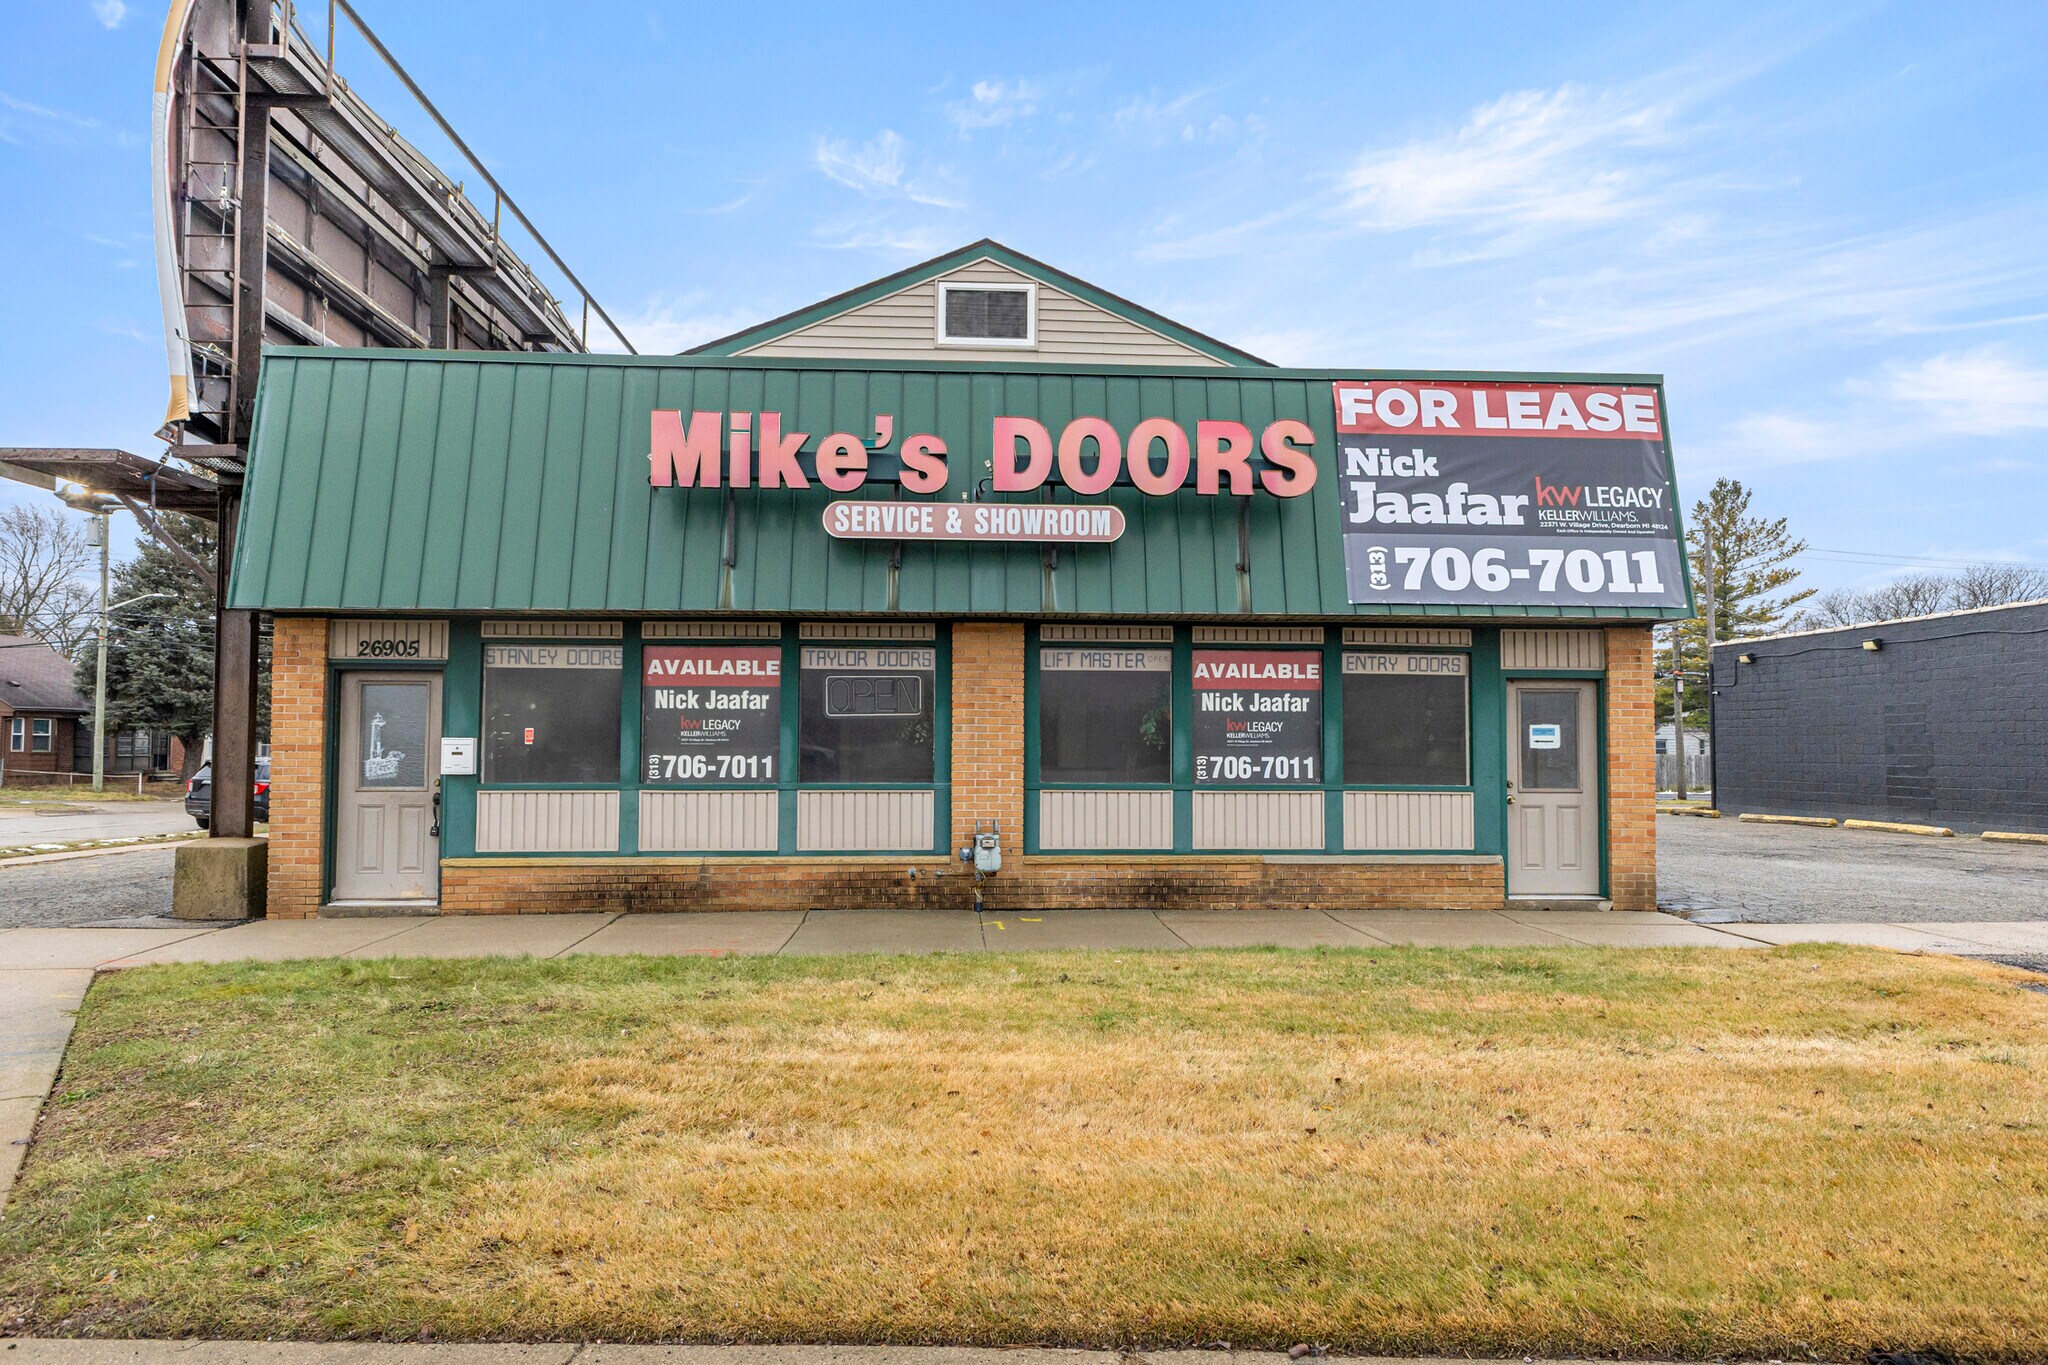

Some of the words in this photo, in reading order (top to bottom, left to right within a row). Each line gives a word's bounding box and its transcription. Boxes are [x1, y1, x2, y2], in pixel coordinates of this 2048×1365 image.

[1339, 388, 1461, 428] FOR
[1472, 390, 1658, 433] LEASE
[650, 409, 949, 494] Mike's
[993, 416, 1319, 498] DOORS
[1345, 448, 1439, 477] Nick
[1535, 475, 1581, 508] kw
[1584, 486, 1663, 509] LEGACY
[1349, 481, 1528, 525] Jaafar
[834, 505, 933, 533] SERVICE
[946, 508, 963, 534] &
[974, 507, 1111, 537] SHOWROOM
[1367, 546, 1391, 591] (313)
[1395, 547, 1665, 594] 706-7011
[358, 639, 420, 657] 26905
[485, 648, 558, 665] STANLEY
[567, 648, 622, 666] DOORS
[806, 650, 868, 667] TAYLOR
[877, 650, 931, 667] DOORS
[647, 659, 780, 676] AVAILABLE
[1044, 652, 1073, 668] LIFT
[1080, 652, 1146, 669] MASTER
[1194, 663, 1320, 679] AVAILABLE
[1346, 655, 1398, 672] ENTRY
[1407, 656, 1461, 673] DOORS
[655, 689, 699, 709] Nick
[705, 689, 770, 710] Jaafar
[830, 678, 918, 713] OPEN
[1201, 692, 1244, 712] Nick
[1249, 693, 1310, 712] Jaafar
[680, 714, 702, 730] kw
[702, 719, 741, 731] LEGACY
[1226, 717, 1246, 732] kw
[1247, 721, 1283, 733] LEGACY
[649, 754, 661, 779] (313)
[662, 754, 772, 779] 706-7011
[1196, 755, 1208, 780] (313)
[1209, 756, 1314, 779] 706-7011
